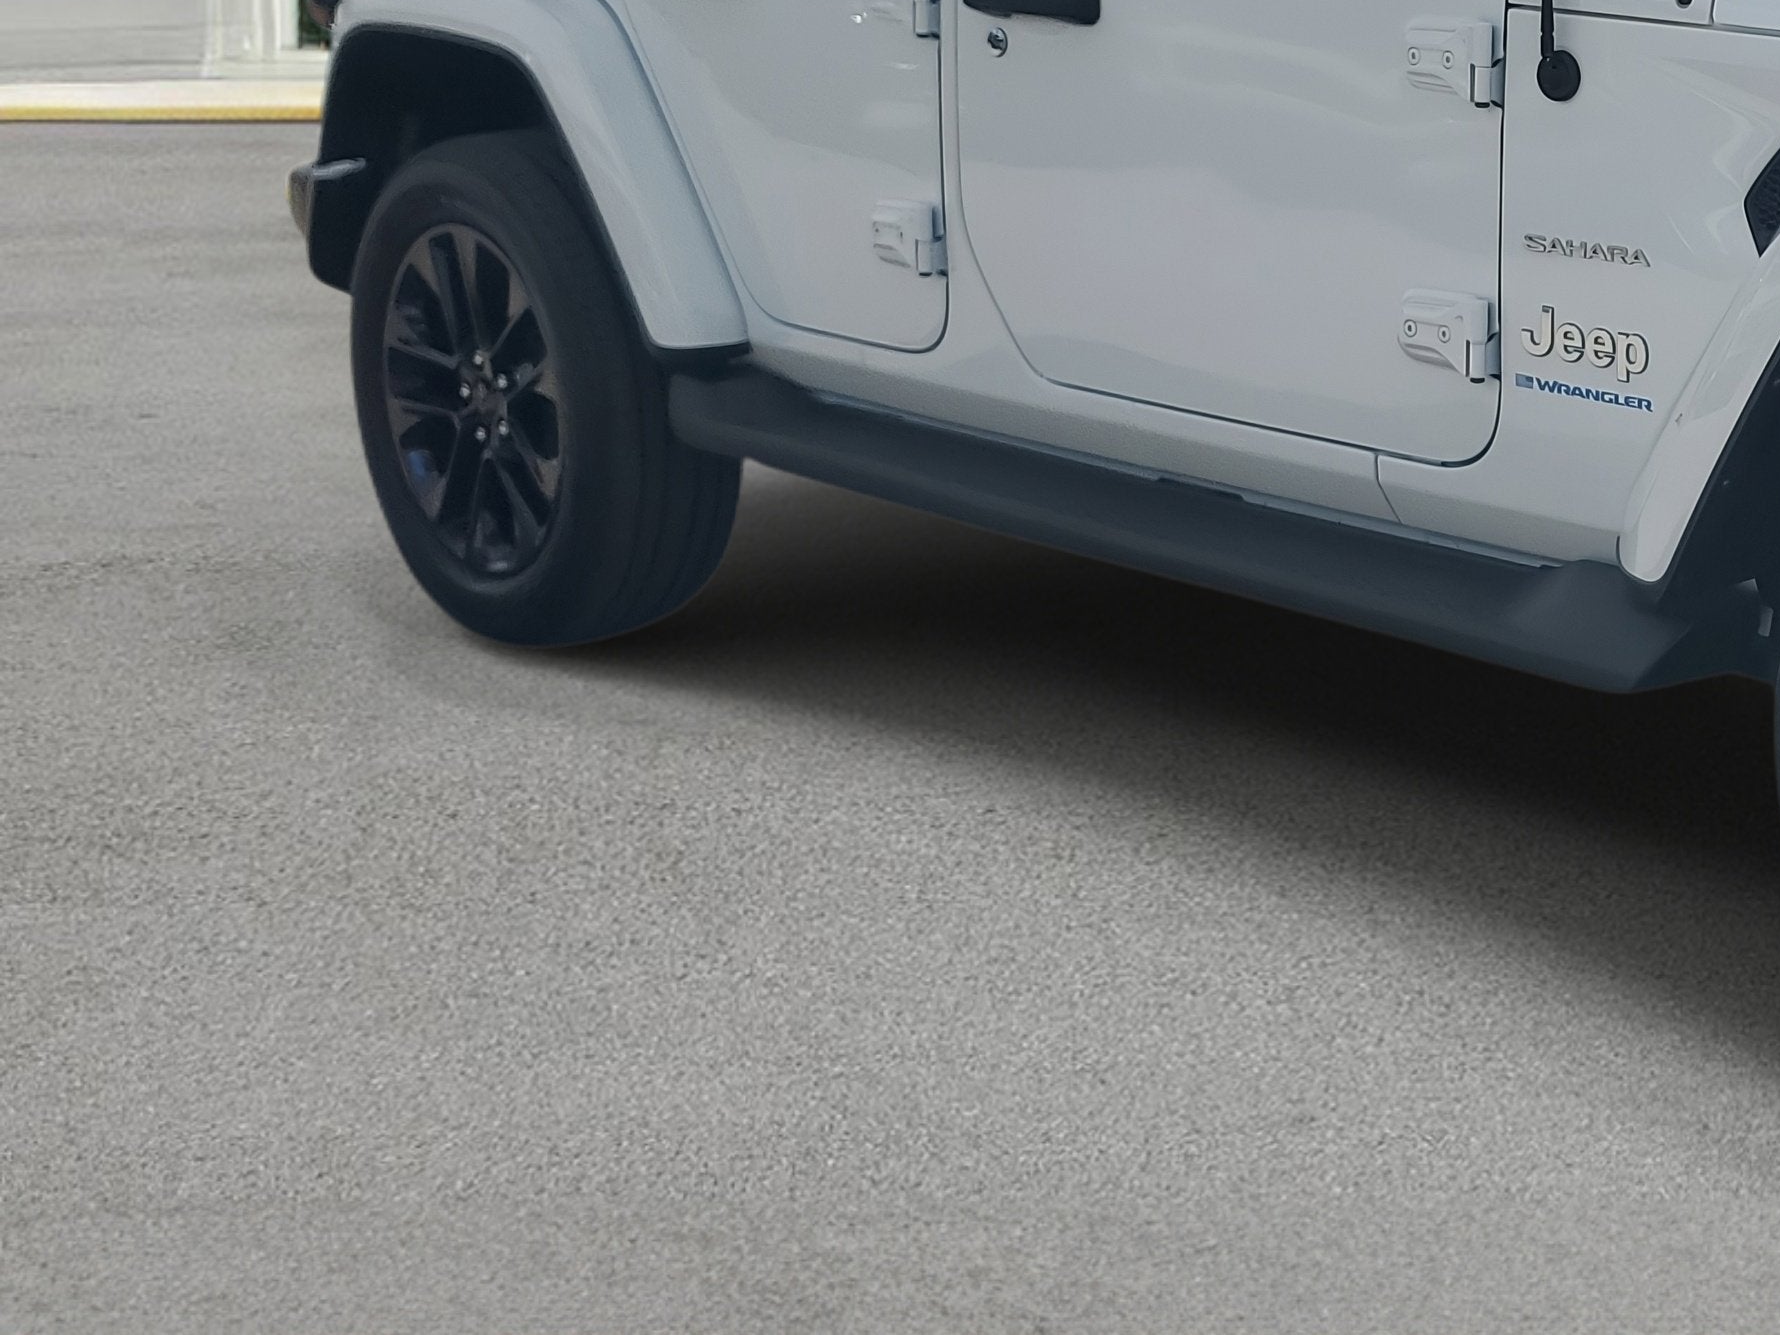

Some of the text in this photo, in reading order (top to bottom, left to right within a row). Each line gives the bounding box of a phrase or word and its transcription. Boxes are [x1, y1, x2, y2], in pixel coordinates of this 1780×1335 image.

[1523, 233, 1651, 268] SAHARA
[1520, 304, 1650, 383] Jeep
[1535, 377, 1653, 412] WRANGLER
